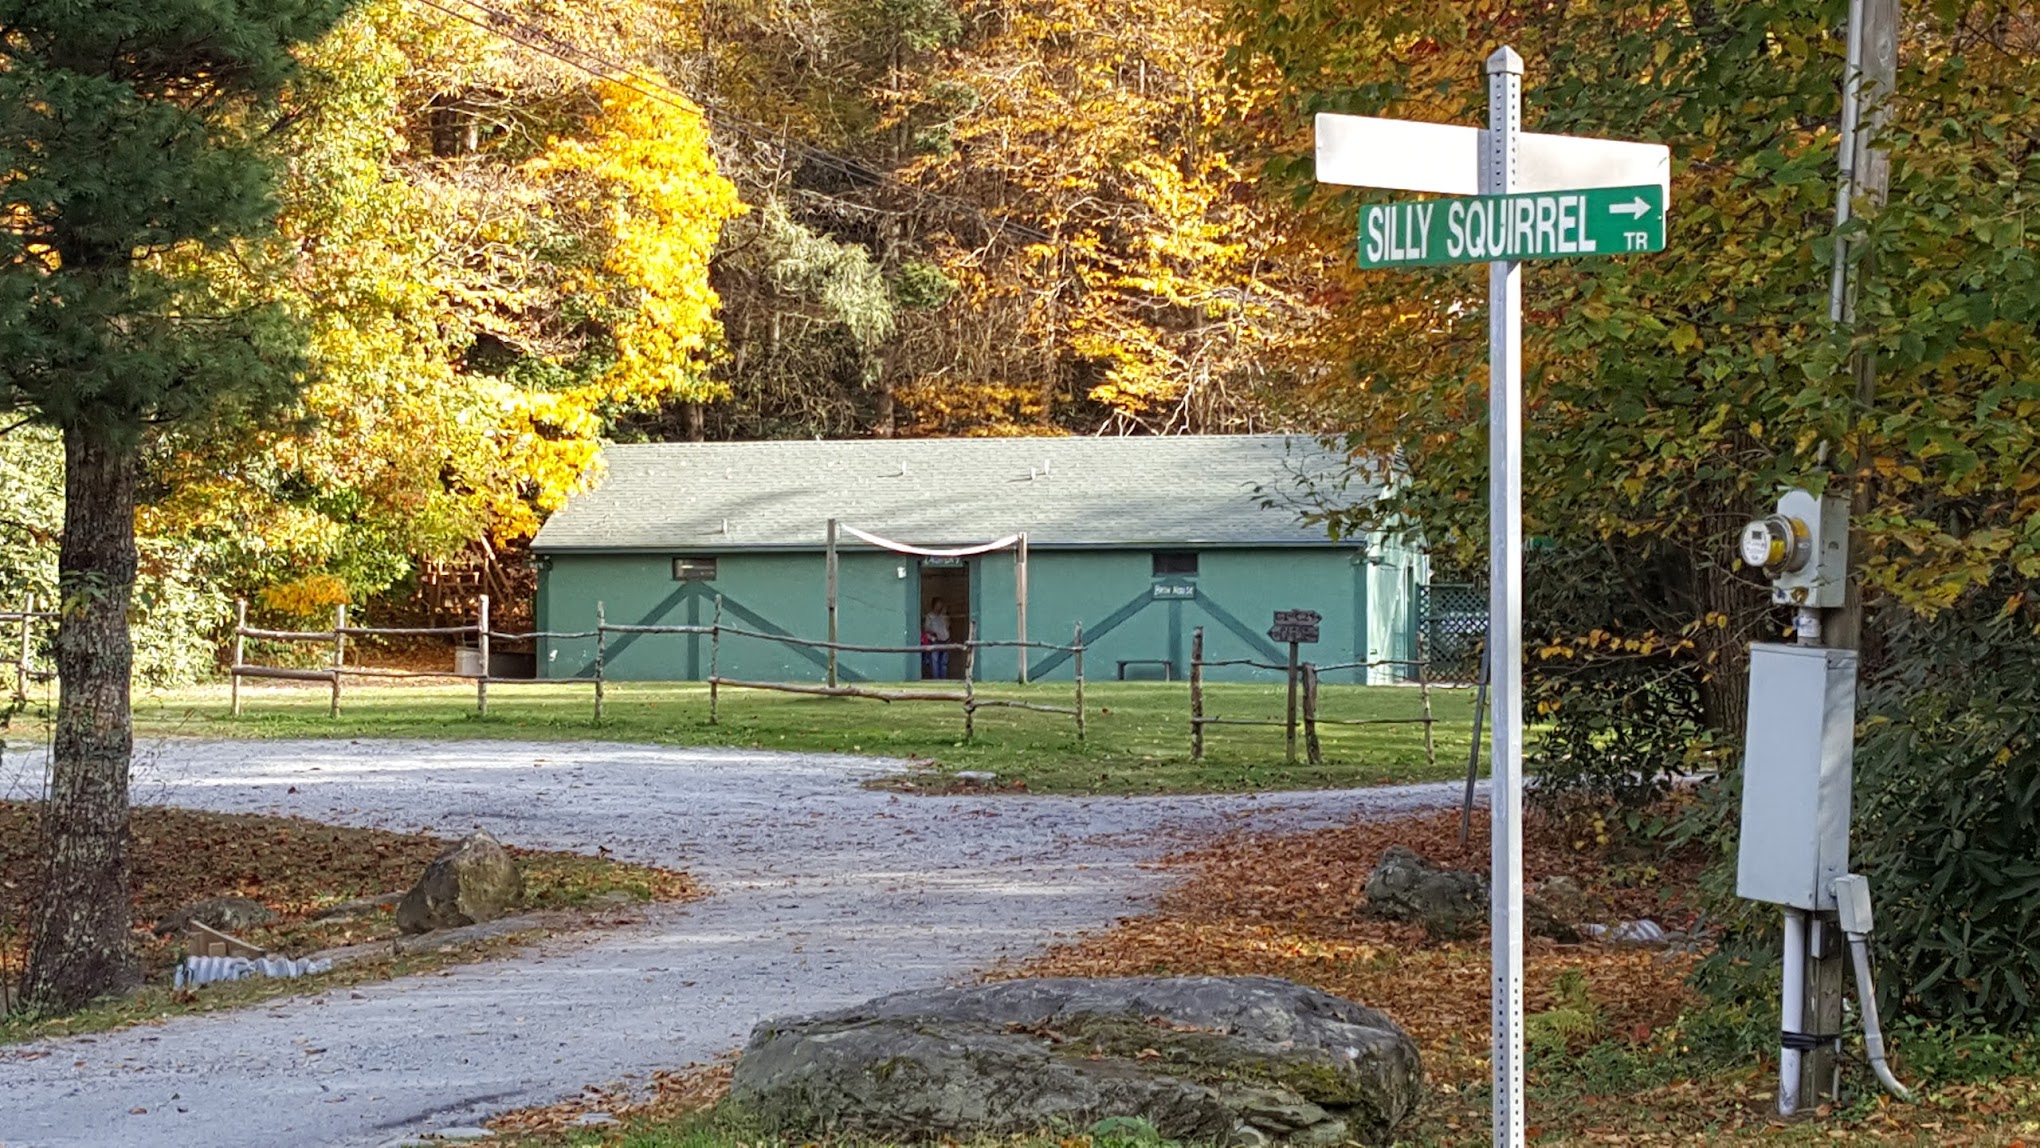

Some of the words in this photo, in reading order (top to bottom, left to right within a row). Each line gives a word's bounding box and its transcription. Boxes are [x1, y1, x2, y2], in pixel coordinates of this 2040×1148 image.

[1366, 202, 1434, 263] SILLY
[1446, 195, 1597, 259] SQUIRREL
[1623, 231, 1649, 251] TR
